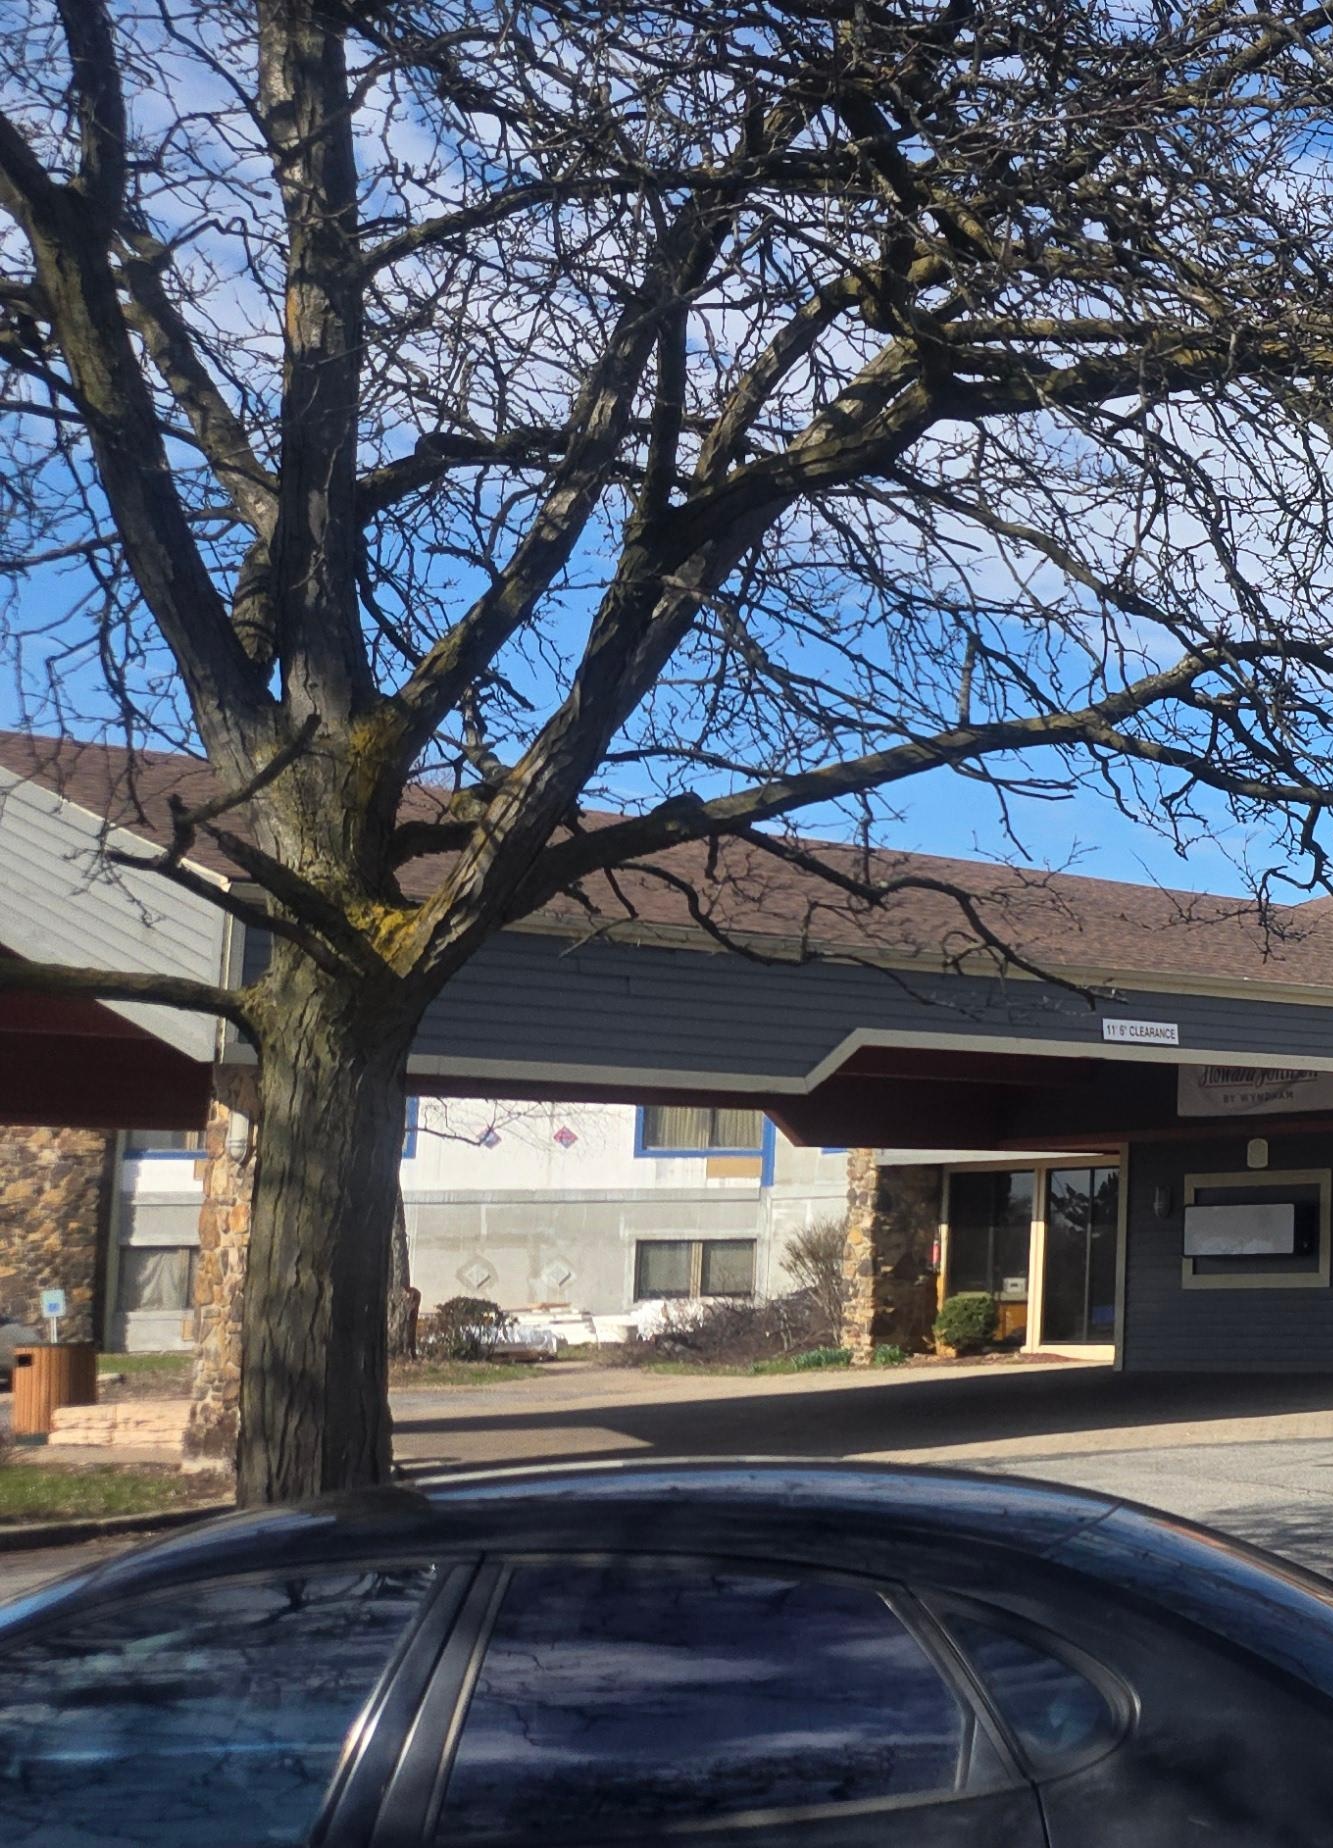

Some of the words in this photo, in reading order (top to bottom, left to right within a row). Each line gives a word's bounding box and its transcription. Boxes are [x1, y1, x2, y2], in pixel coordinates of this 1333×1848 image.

[1129, 1025, 1176, 1040] CLEARANCE
[1223, 1094, 1235, 1104] BY
[1240, 1090, 1294, 1103] WYNDHAM
